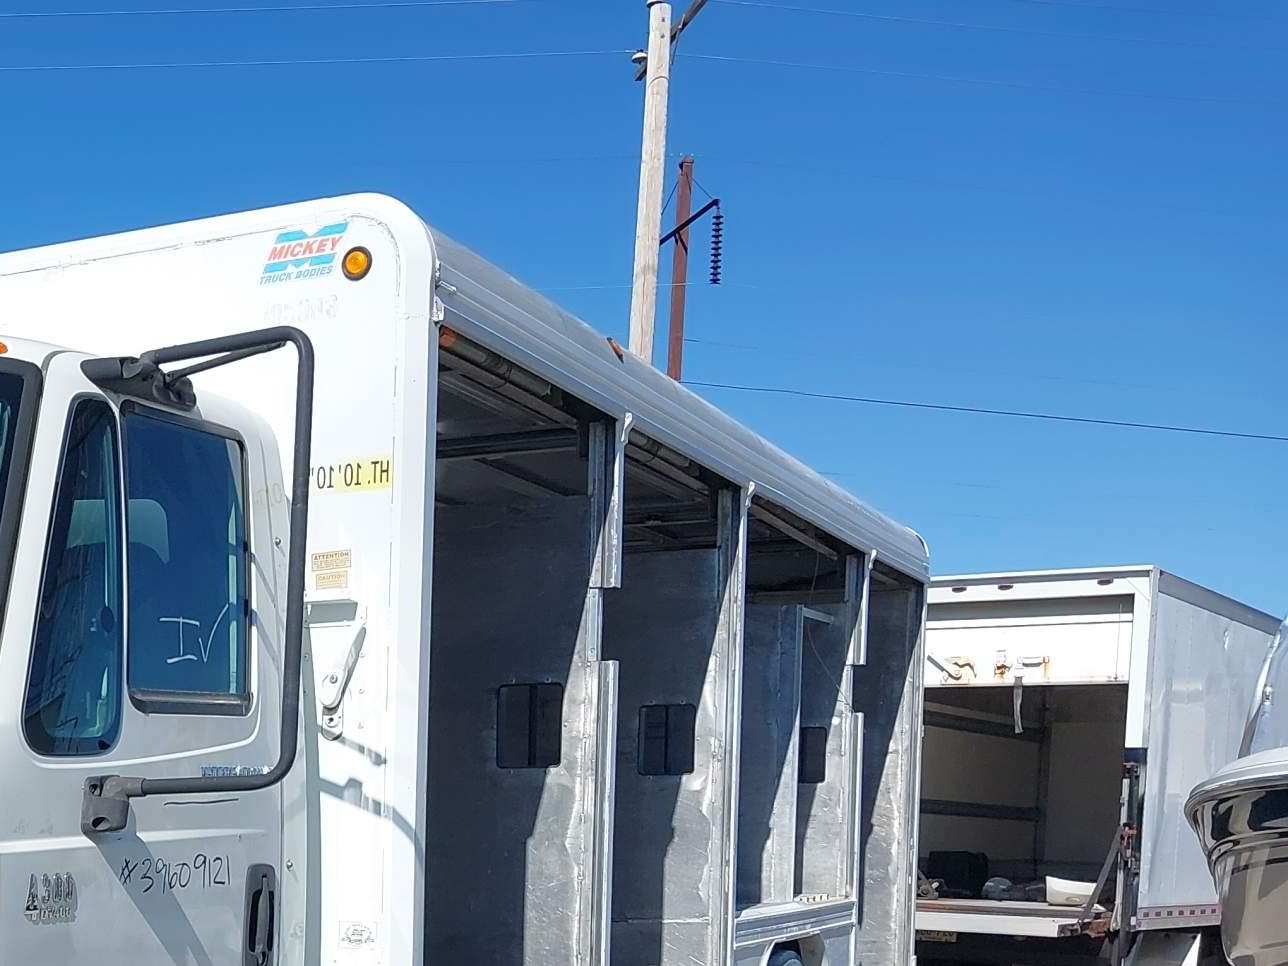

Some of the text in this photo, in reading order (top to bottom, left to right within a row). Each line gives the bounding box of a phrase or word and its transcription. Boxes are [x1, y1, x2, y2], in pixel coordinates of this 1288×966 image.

[267, 235, 343, 262] MICKEY
[259, 265, 334, 286] TRUCK BODIES
[313, 551, 349, 561] ATTENTION
[118, 853, 232, 894] #39609121
